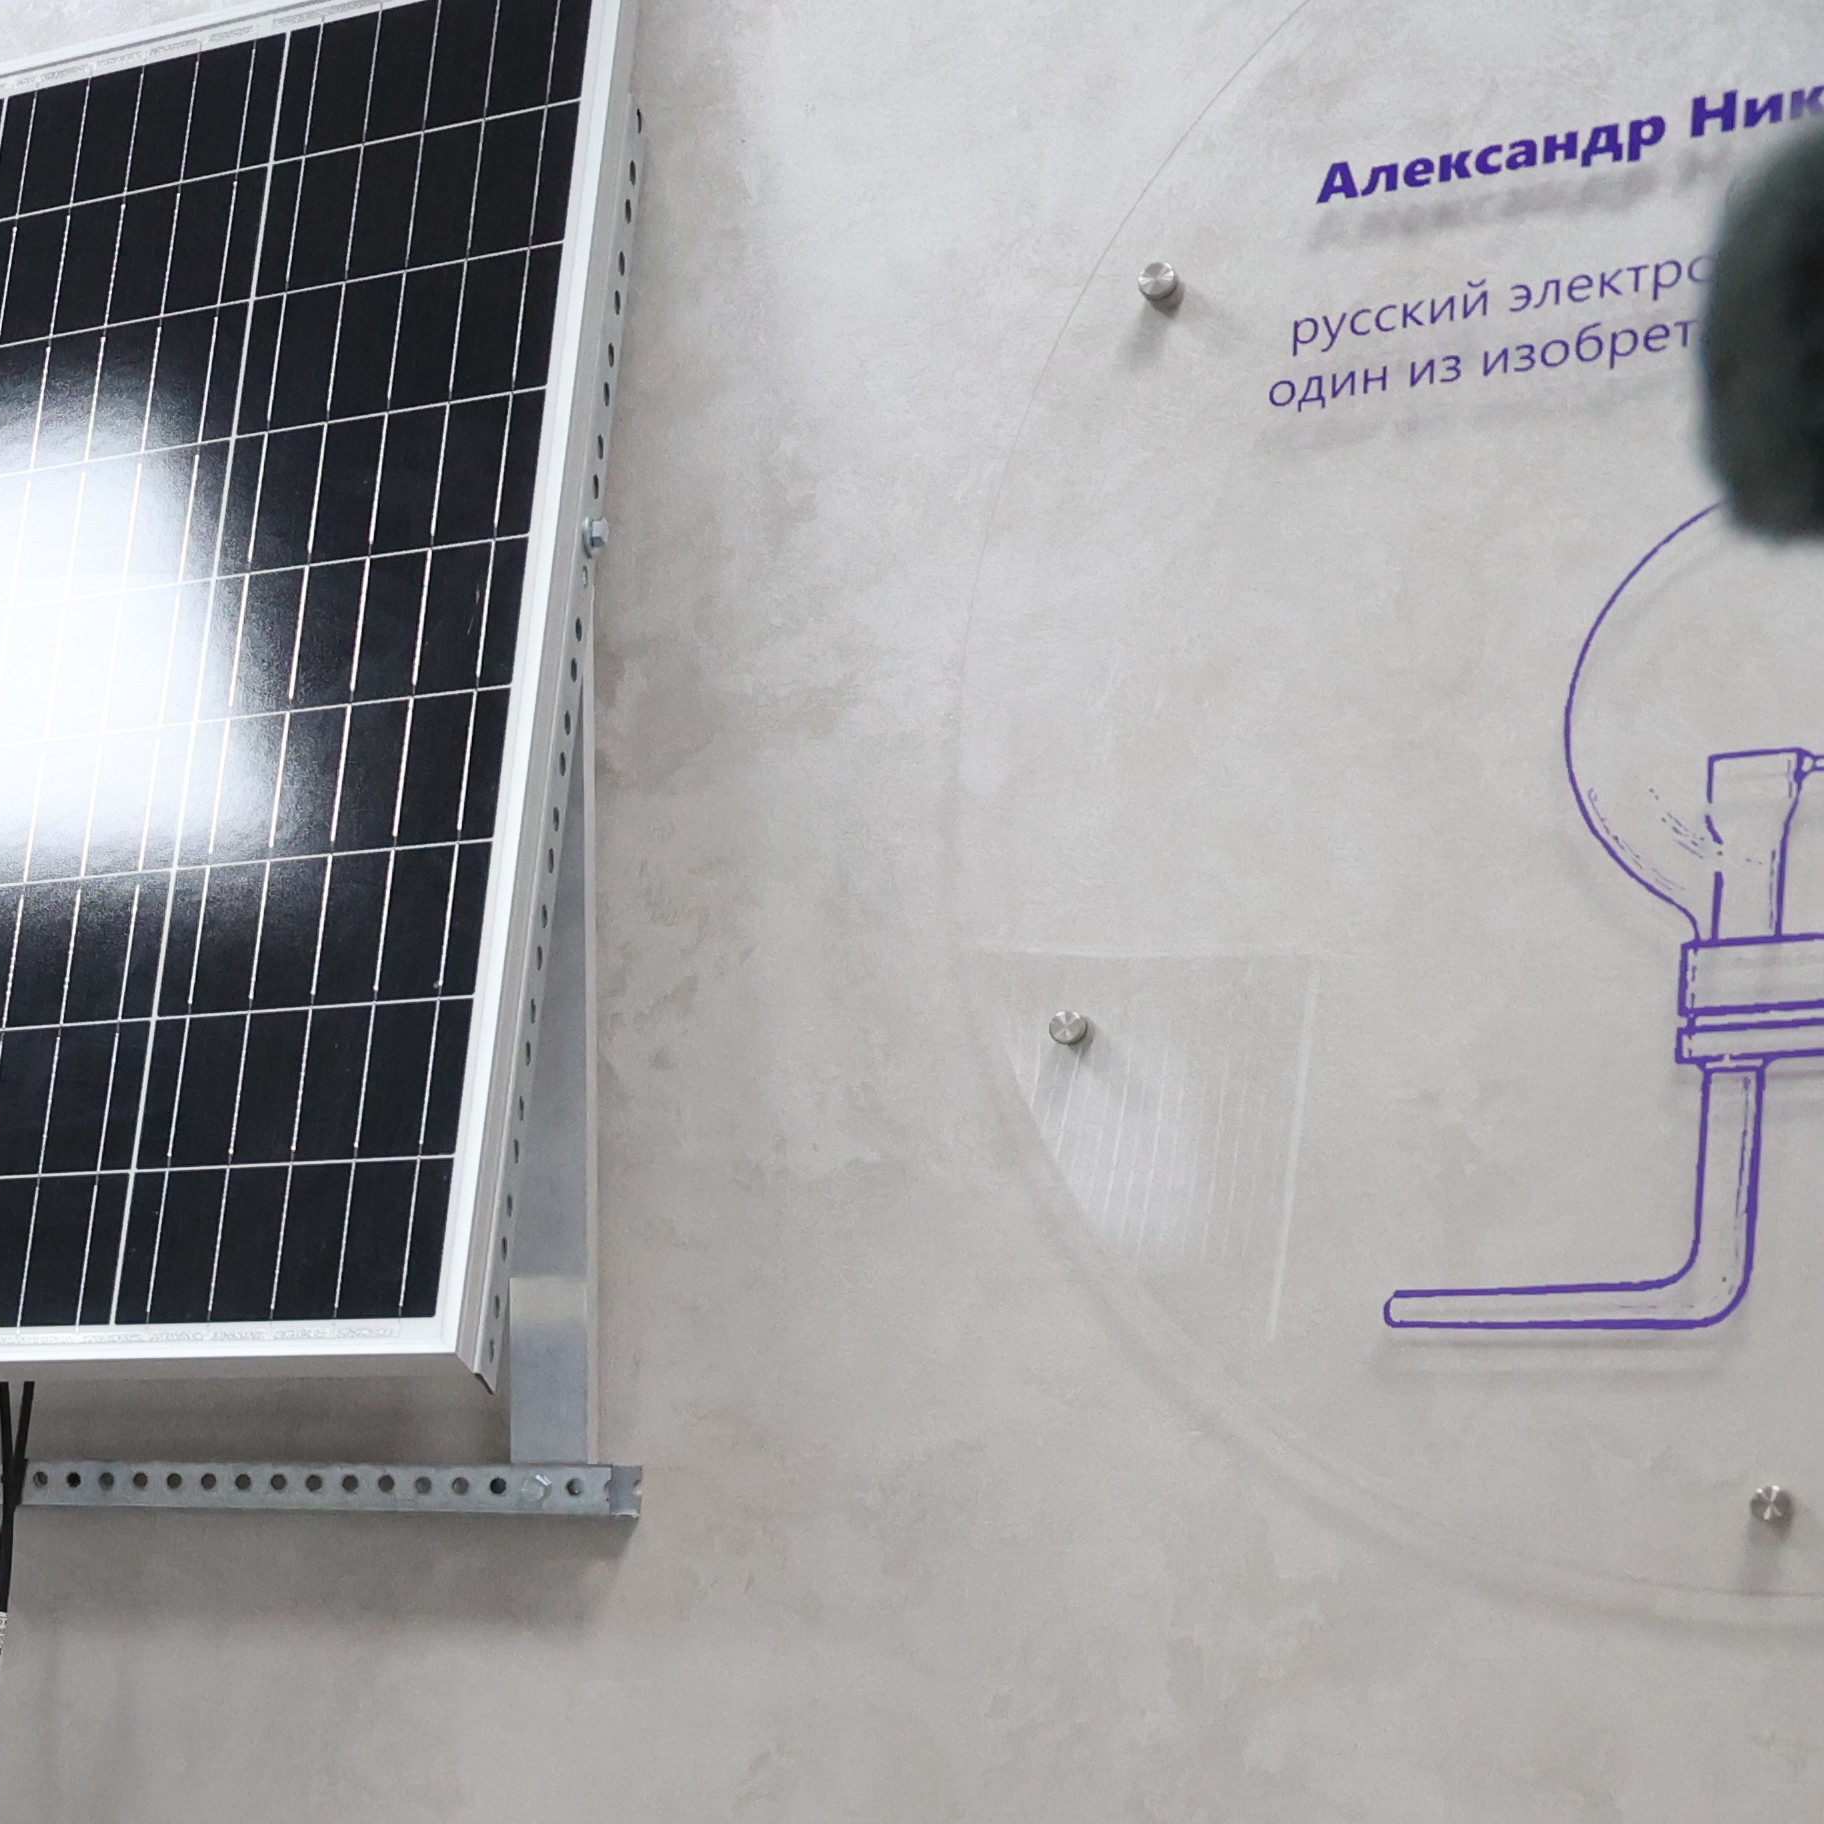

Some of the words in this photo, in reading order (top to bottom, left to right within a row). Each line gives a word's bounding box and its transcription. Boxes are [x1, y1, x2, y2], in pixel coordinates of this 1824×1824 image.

[1316, 115, 1666, 204] Александр
[1292, 278, 1489, 357] русский
[1268, 365, 1388, 413] один
[1409, 354, 1462, 388] из
